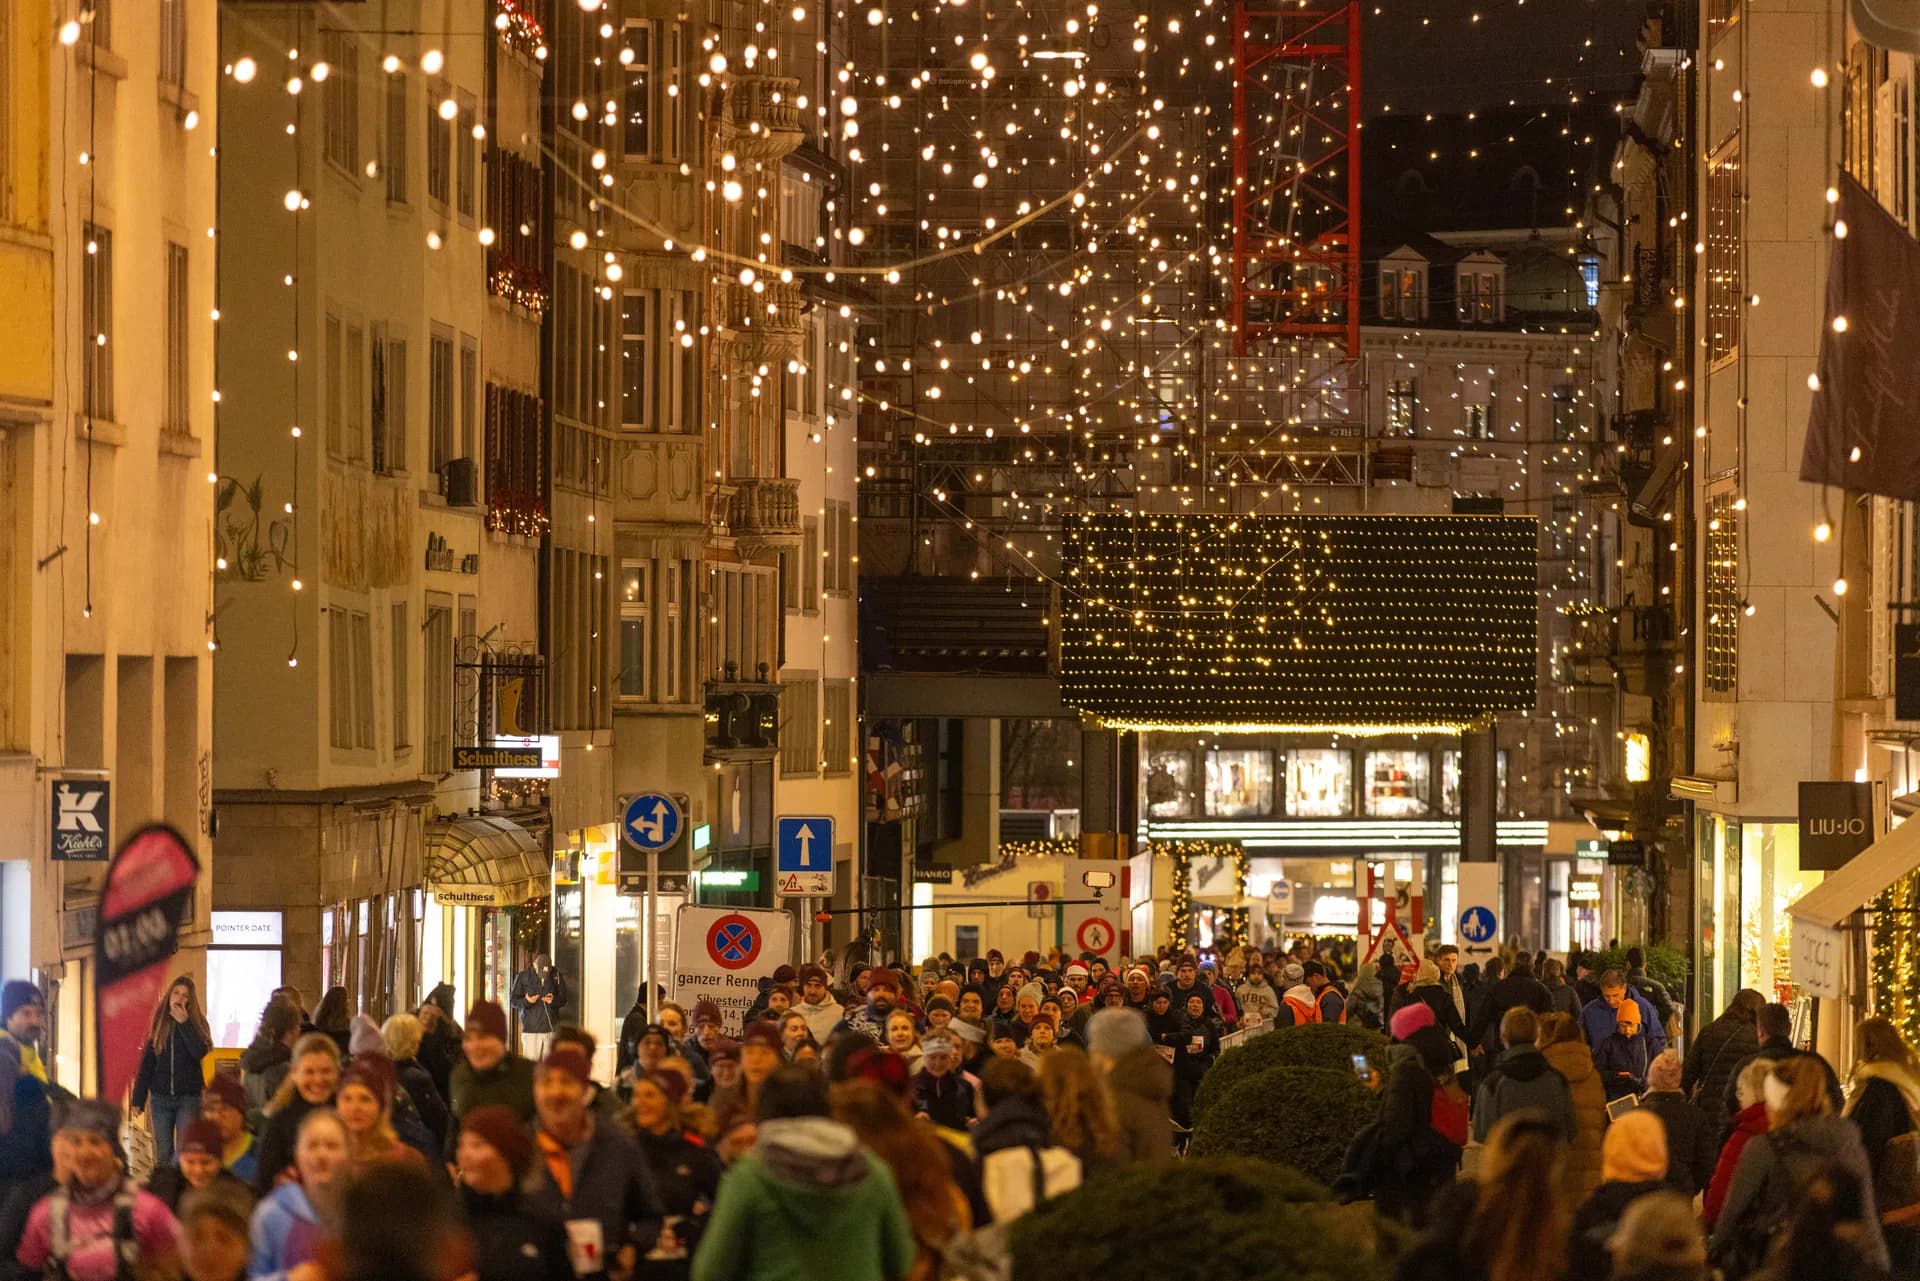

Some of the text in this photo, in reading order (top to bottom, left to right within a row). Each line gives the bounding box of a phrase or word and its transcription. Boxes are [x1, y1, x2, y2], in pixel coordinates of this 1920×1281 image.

[458, 750, 538, 766] Schulthess
[57, 833, 102, 851] Kiehl's
[438, 891, 495, 901] schulthess
[215, 924, 272, 932] POINTER DATE
[678, 974, 758, 988] ganzer Renn
[696, 993, 753, 1007] Silvesterla
[723, 1009, 746, 1020] 14.1
